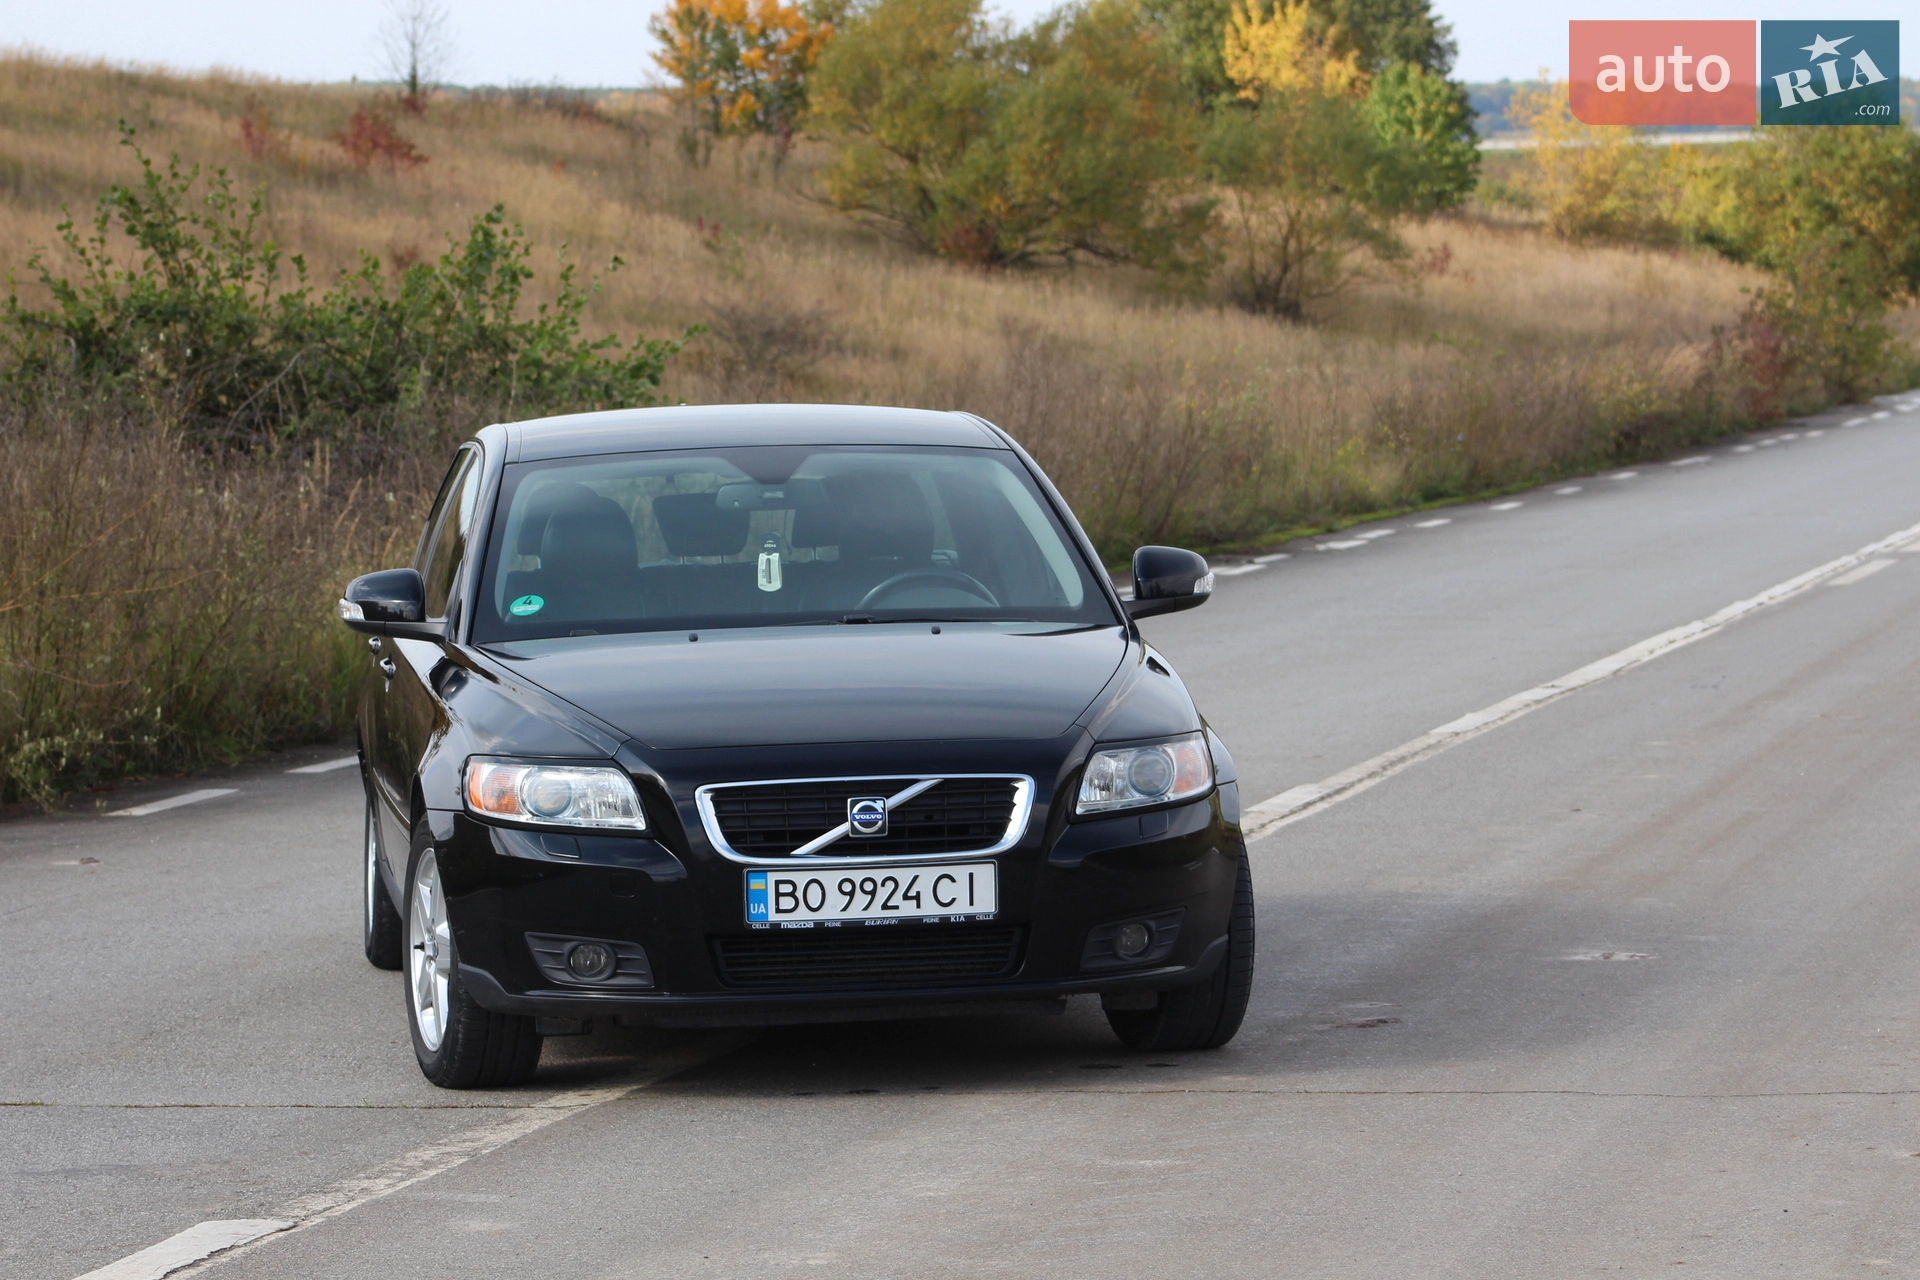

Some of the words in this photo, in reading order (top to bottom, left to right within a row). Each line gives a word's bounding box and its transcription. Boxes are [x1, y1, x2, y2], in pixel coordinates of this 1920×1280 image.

[522, 595, 532, 605] 4
[774, 878, 826, 914] BO
[837, 874, 921, 912] 9924
[932, 872, 974, 908] CI
[750, 902, 766, 914] UA
